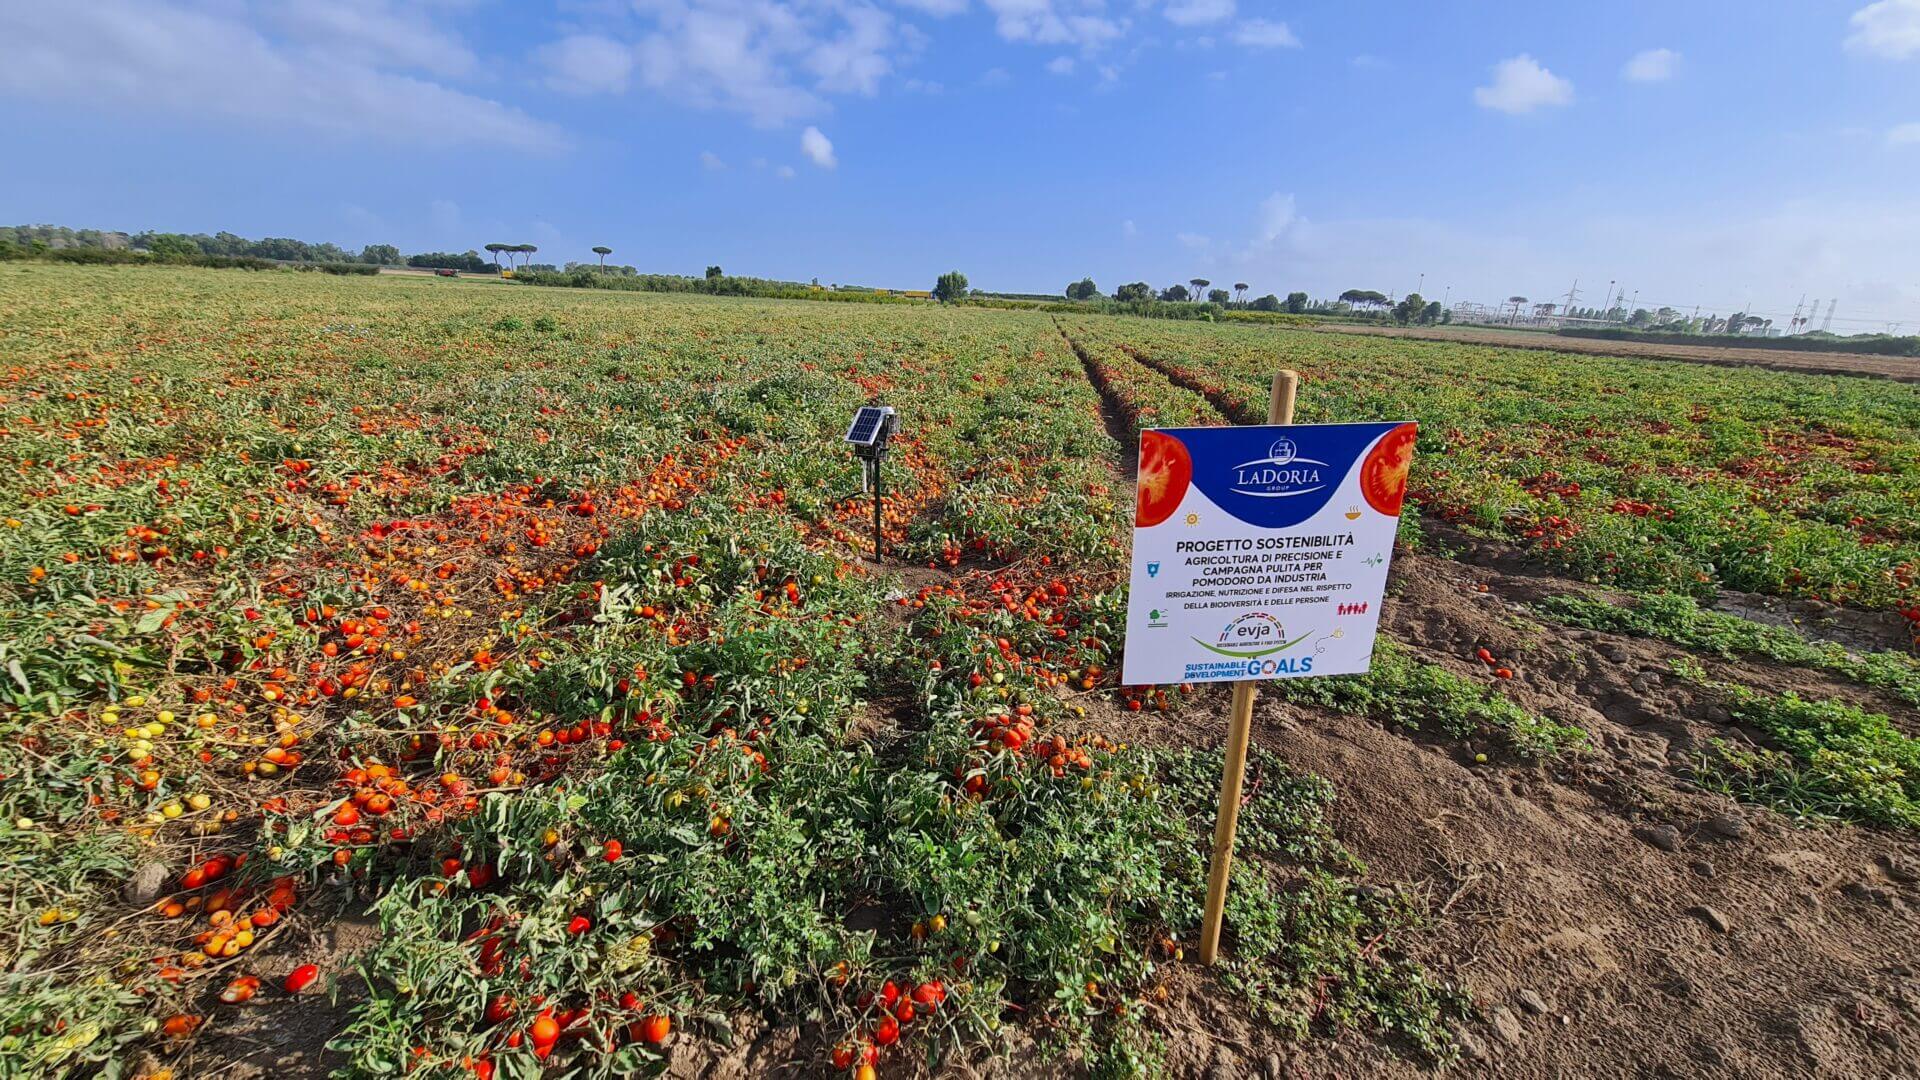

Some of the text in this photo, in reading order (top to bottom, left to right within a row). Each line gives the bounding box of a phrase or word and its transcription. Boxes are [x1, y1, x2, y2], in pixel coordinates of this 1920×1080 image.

[1176, 531, 1354, 553] PROGETTO SOSTENIBILITÀ
[1184, 550, 1343, 566] AGRICOLTURA DI PRECISIONE E
[1203, 562, 1323, 576] CAMPAGNA PULITA PER
[1192, 572, 1327, 587] POMODORO DA INDUSTRIA
[1165, 590, 1216, 598] IRRIGAZIONE,
[1218, 588, 1264, 596] NUTRIZIONE
[1272, 586, 1298, 594] DIFESA
[1316, 583, 1352, 591] RISPETTO
[1184, 602, 1208, 610] DELLA
[1210, 598, 1262, 609] BIODIVERSITÀ
[1270, 598, 1293, 606] DELLE
[1295, 596, 1330, 604] PERSONE
[1237, 623, 1270, 640] evja
[1185, 660, 1247, 671] SUSTAINABLE
[1247, 656, 1313, 675] GOALS
[1184, 669, 1247, 679] DEVELOPMENT
